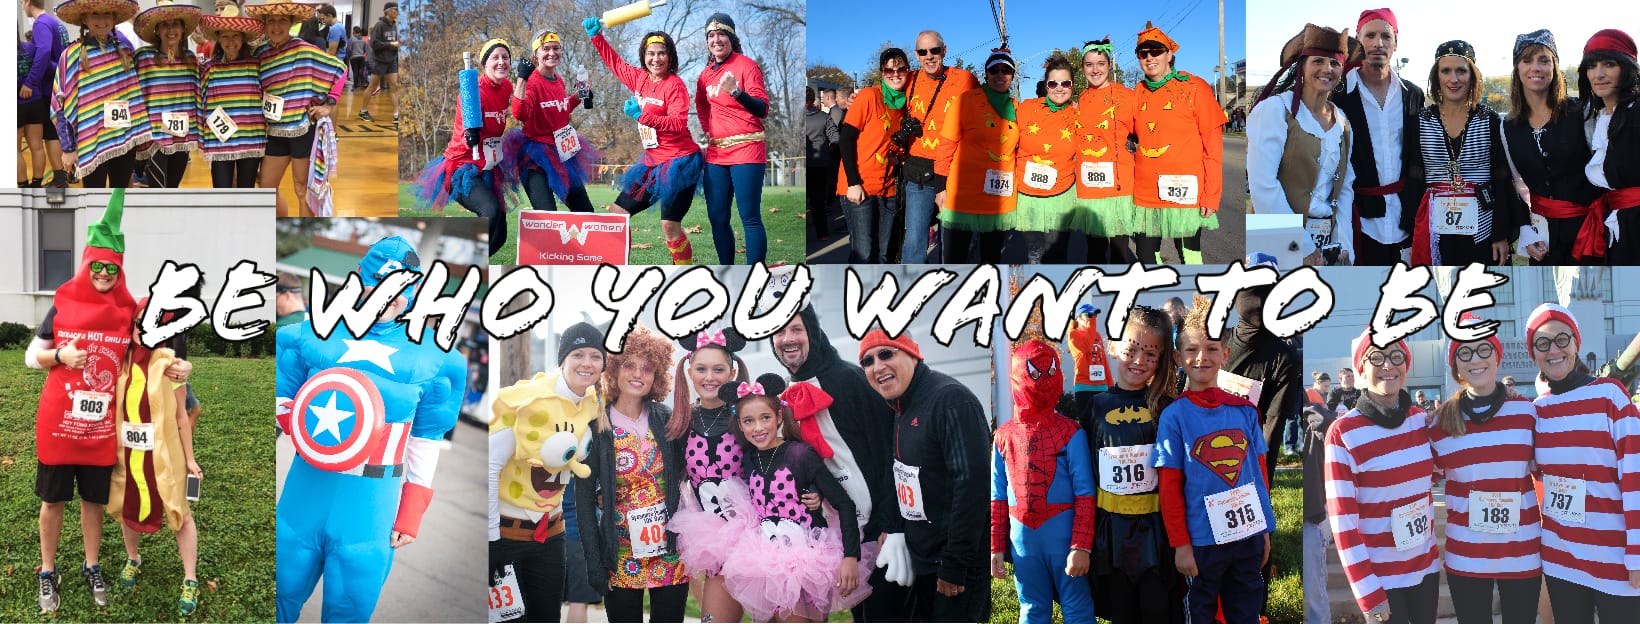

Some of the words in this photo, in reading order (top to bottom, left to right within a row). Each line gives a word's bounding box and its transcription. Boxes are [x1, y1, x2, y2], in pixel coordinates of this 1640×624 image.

[167, 119, 184, 131] 781
[212, 115, 230, 135] 179
[560, 135, 577, 154] 620
[1445, 210, 1463, 226] 87
[539, 251, 575, 263] Kicking
[576, 253, 603, 262] Some
[87, 331, 103, 342] HOT
[80, 399, 103, 413] 803
[126, 430, 147, 443] 804
[1112, 463, 1145, 484] 316
[1550, 491, 1574, 511] 737
[1225, 503, 1256, 529] 315
[1405, 514, 1429, 538] 182
